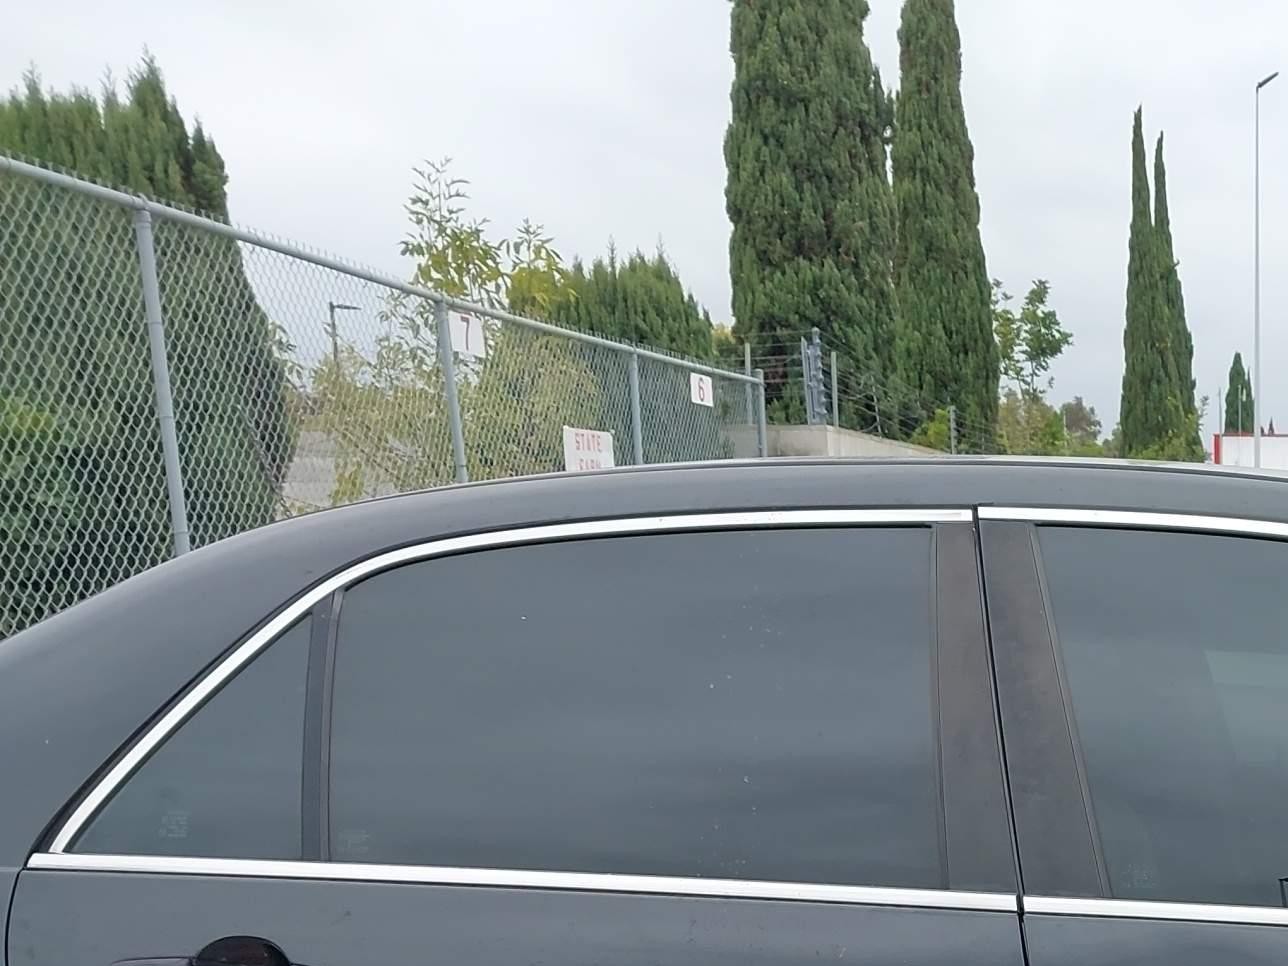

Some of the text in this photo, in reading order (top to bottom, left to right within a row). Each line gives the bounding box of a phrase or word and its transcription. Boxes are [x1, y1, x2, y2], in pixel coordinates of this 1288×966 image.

[460, 315, 470, 351] 7
[697, 376, 705, 402] 6
[575, 432, 602, 453] STATE
